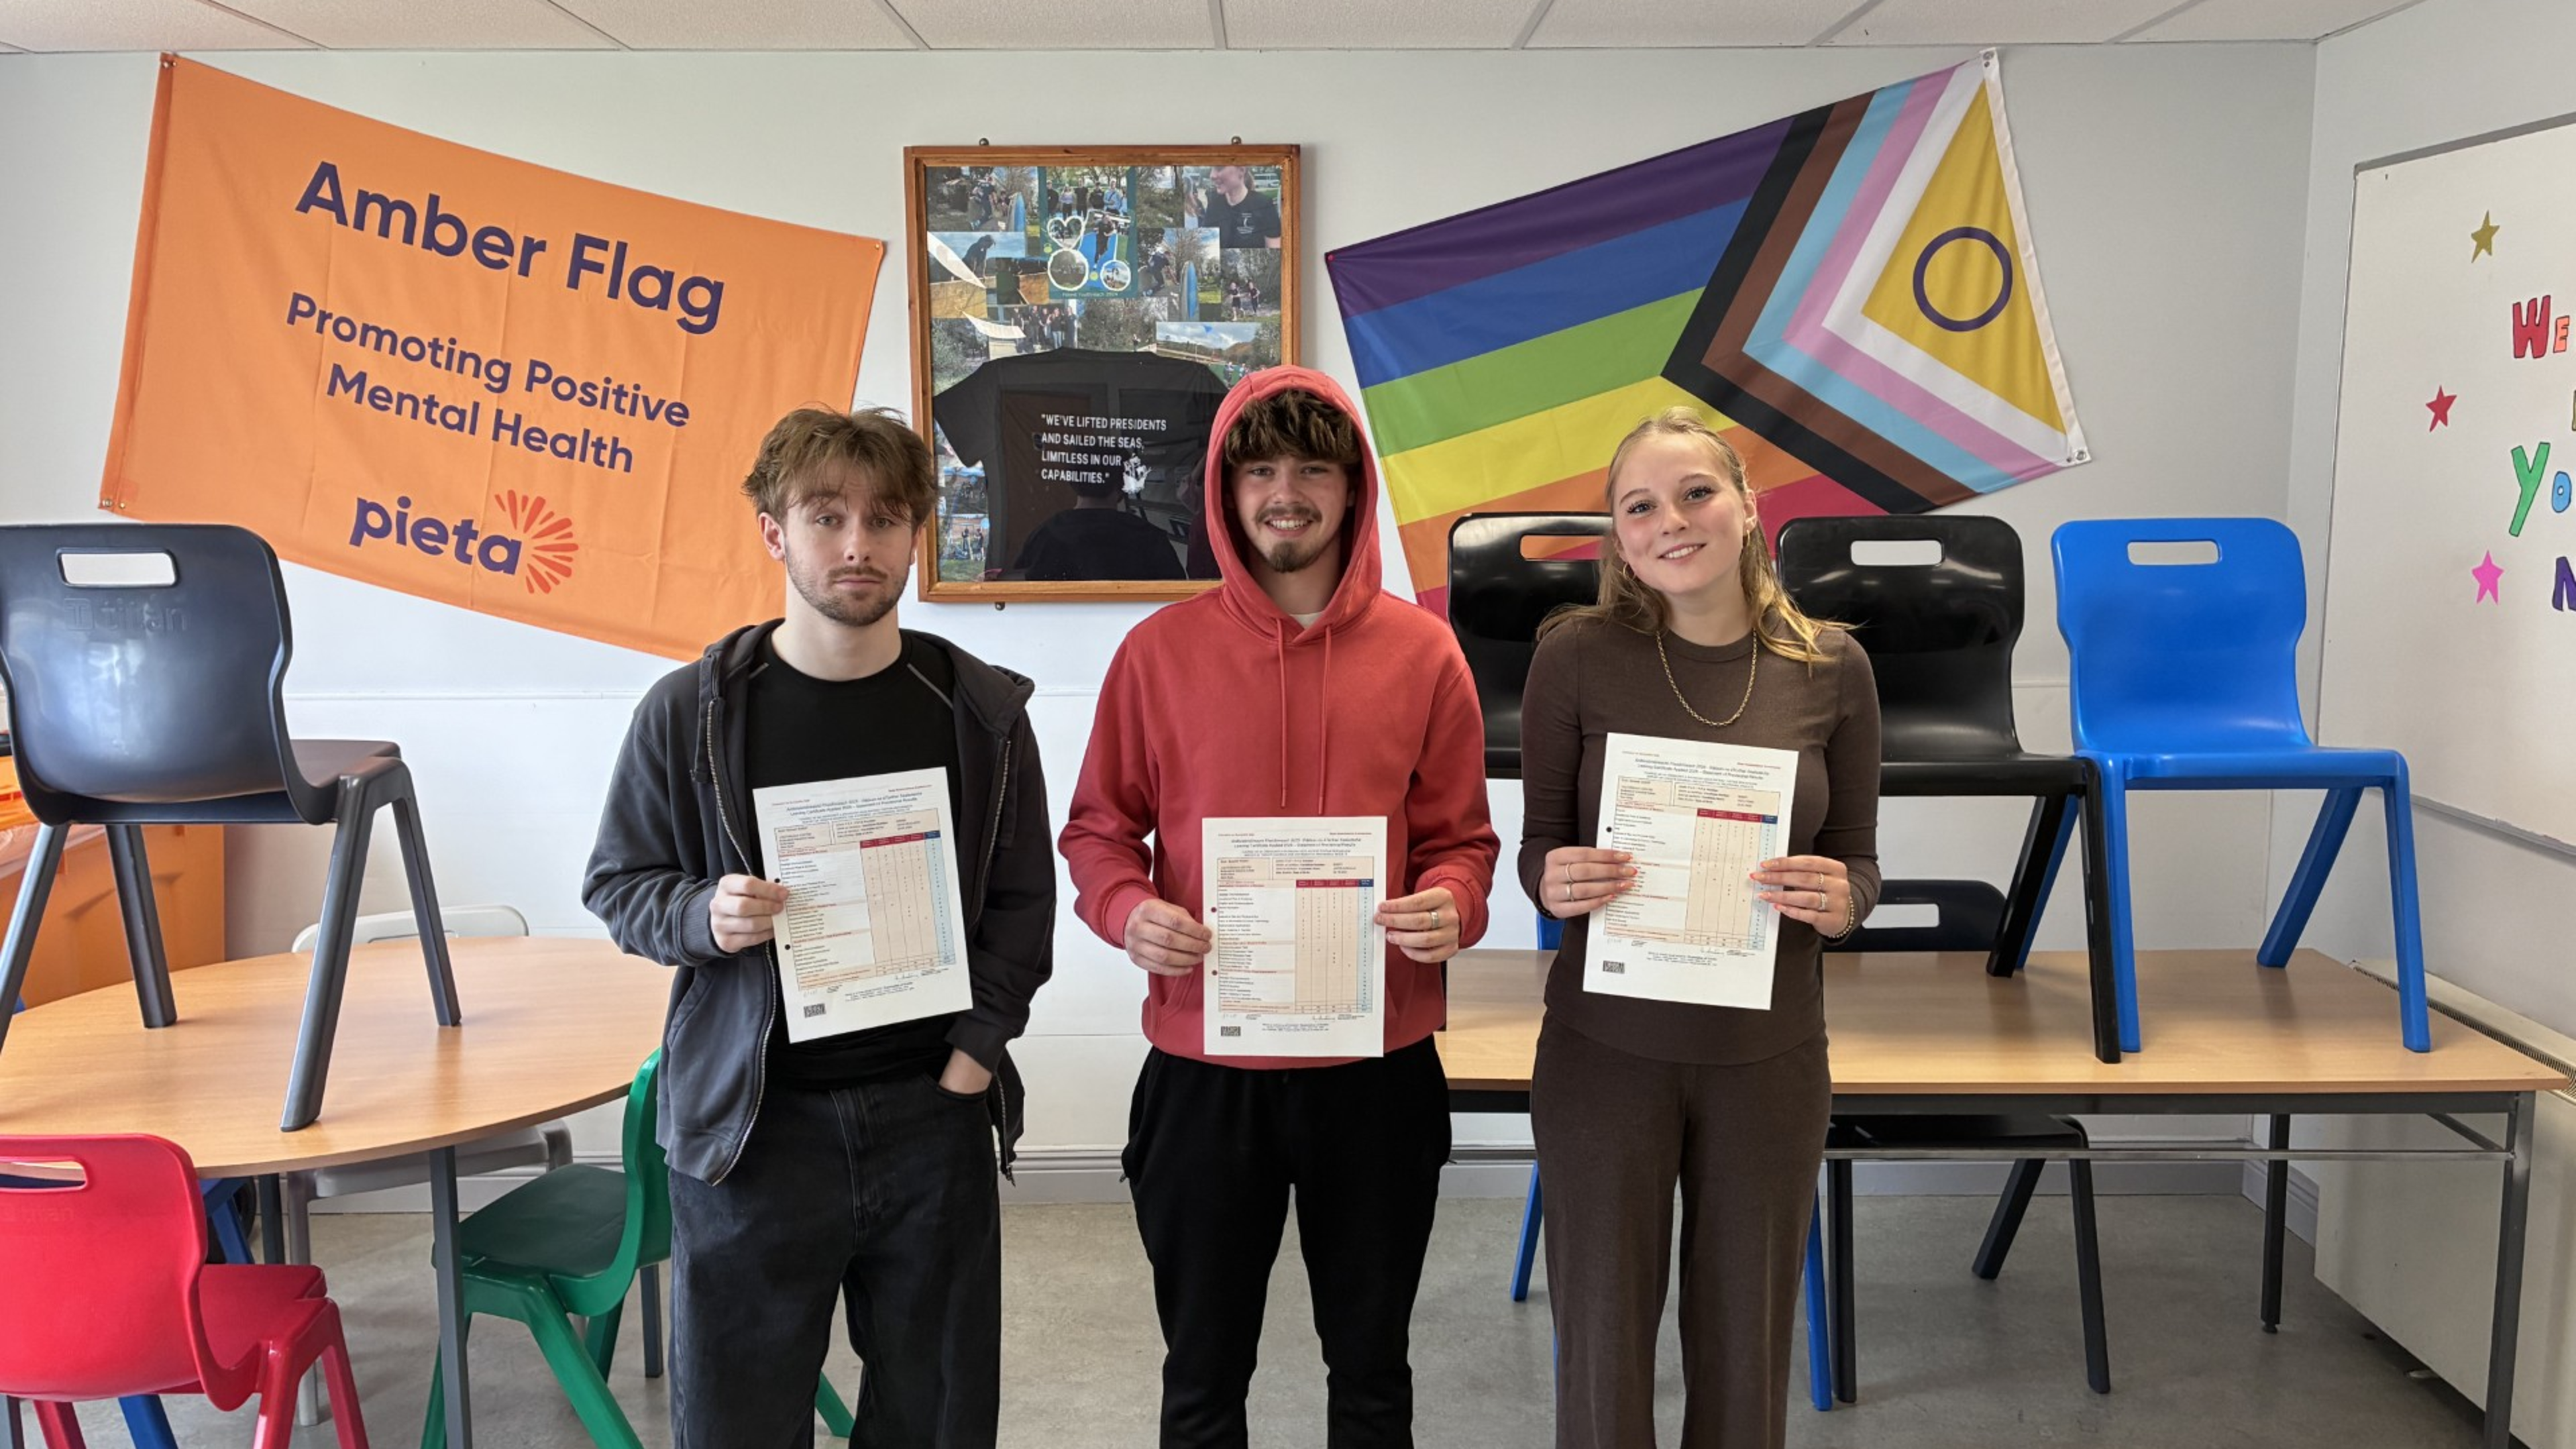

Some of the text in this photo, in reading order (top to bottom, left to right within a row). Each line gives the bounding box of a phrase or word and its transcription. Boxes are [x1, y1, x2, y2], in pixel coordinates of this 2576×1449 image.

[295, 162, 726, 335] Amber Flag
[286, 292, 690, 429] Promoting Positive
[327, 363, 634, 474] Mental Health
[1040, 413, 1167, 431] "WE'VE LIFTED PRESIDENTS
[1041, 432, 1061, 445] AND
[1063, 434, 1095, 447] SAILED
[1097, 435, 1116, 448] THE
[1040, 468, 1110, 484] CAPABILITIES."
[1041, 450, 1122, 466] LIMITLESS IN OUR
[349, 495, 523, 576] pieta
